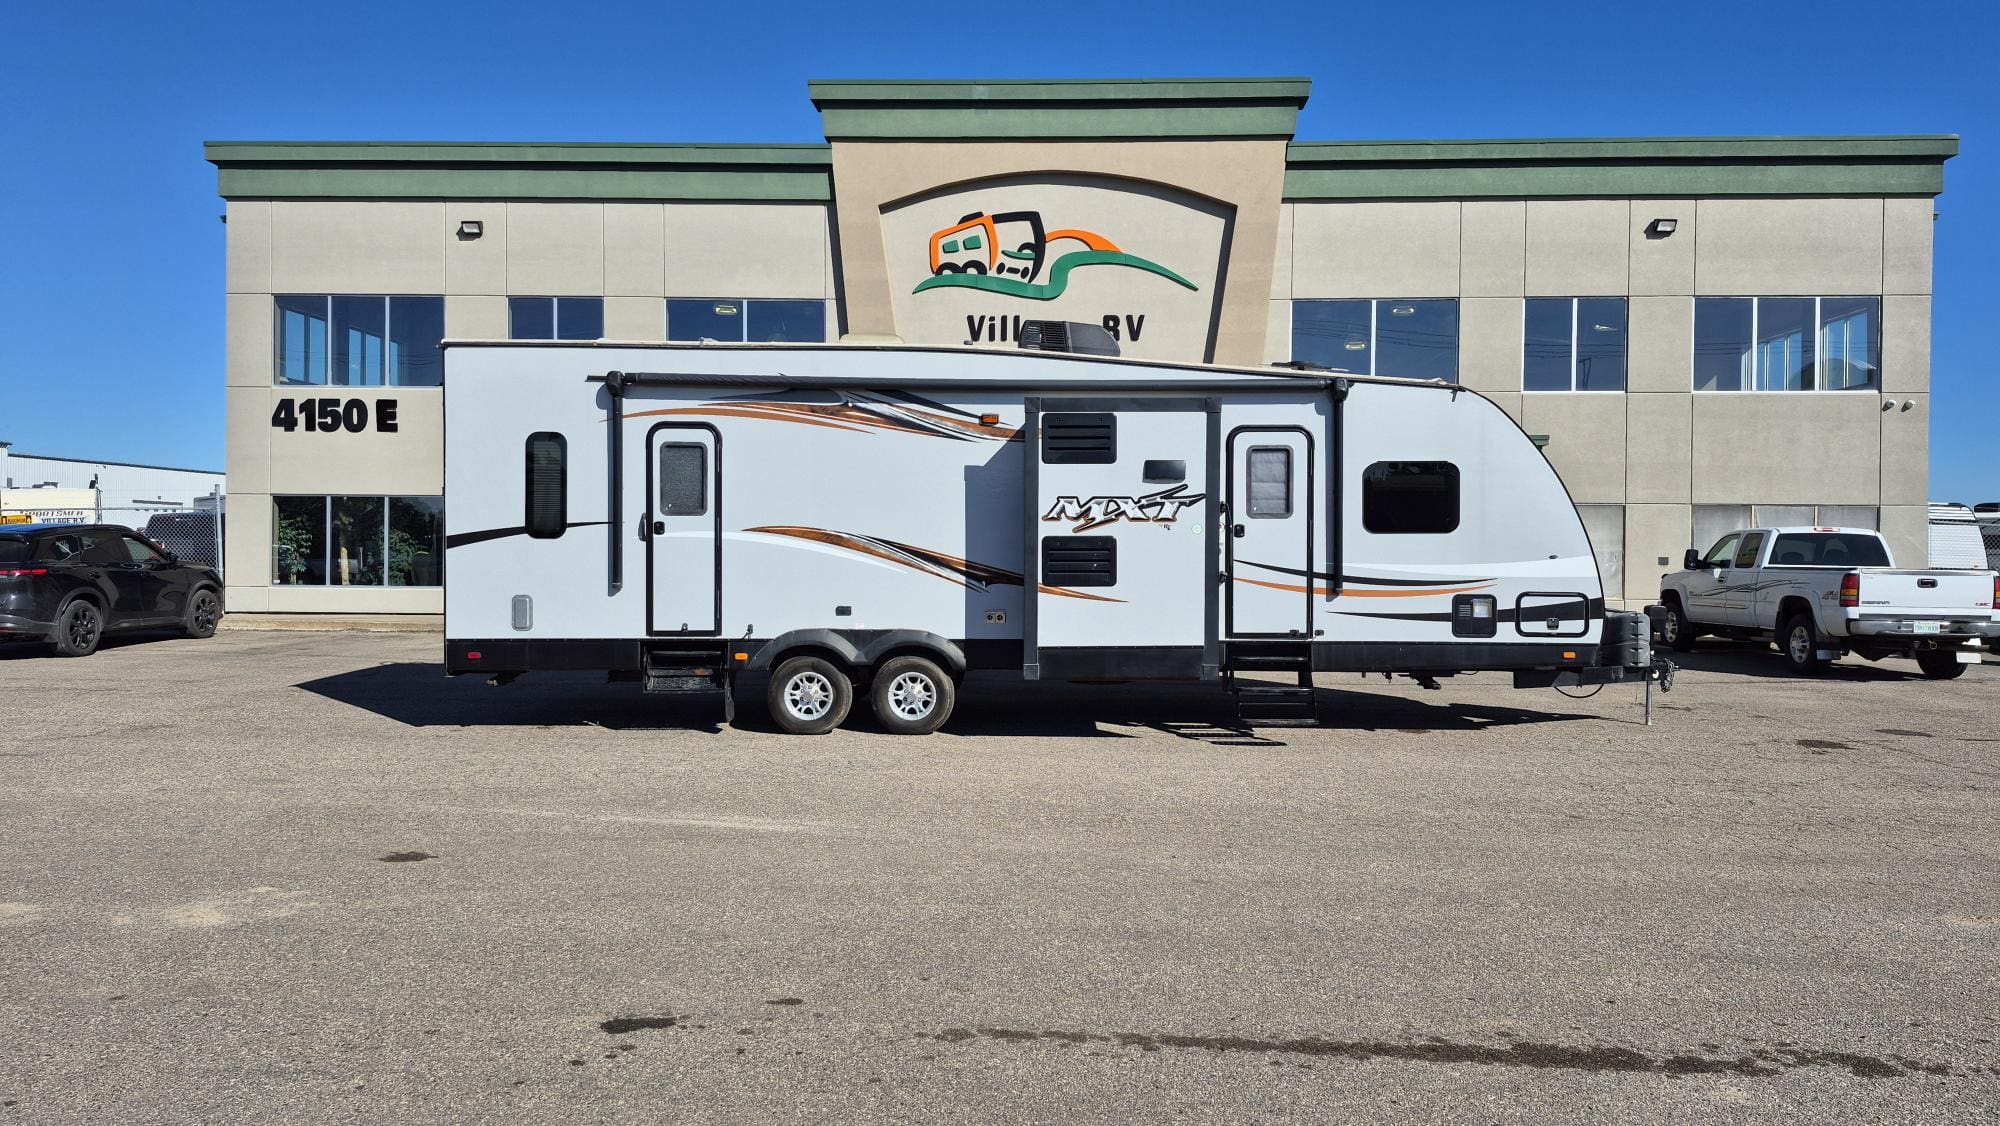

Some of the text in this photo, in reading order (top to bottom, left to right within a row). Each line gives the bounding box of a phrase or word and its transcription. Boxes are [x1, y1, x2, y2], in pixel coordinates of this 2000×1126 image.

[967, 315, 1145, 342] Vill RV
[272, 398, 398, 433] 4150 E
[1042, 484, 1206, 533] MXT
